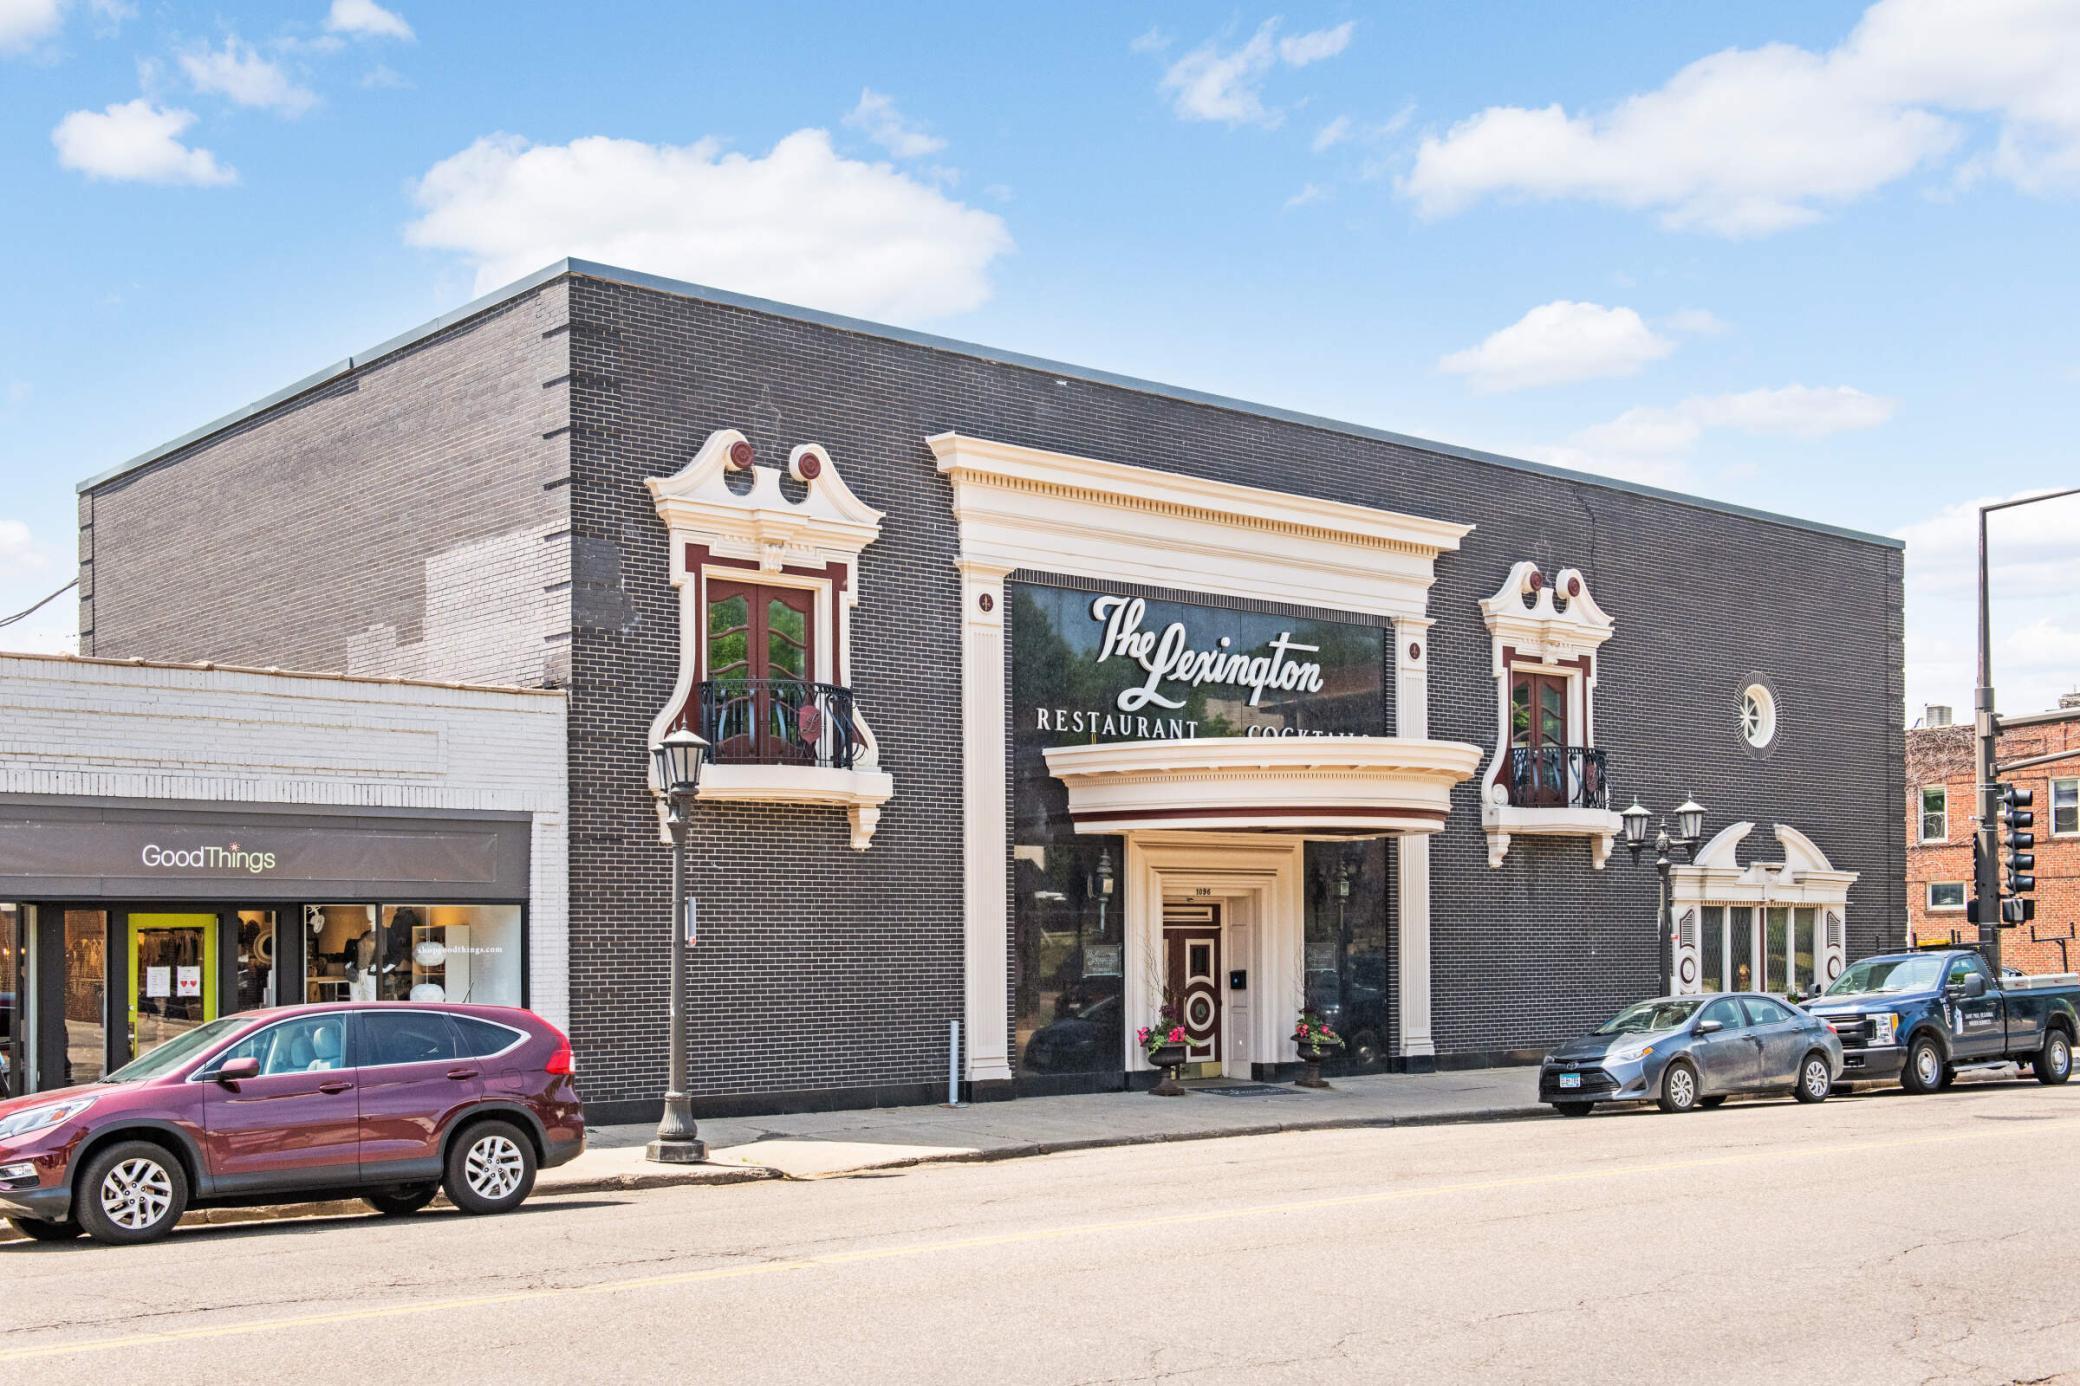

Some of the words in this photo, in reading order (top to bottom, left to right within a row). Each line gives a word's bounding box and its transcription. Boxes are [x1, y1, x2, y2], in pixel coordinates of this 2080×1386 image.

[1093, 596, 1156, 663] The
[1117, 622, 1323, 712] Lexington
[1036, 707, 1199, 739] RESTAURANT
[142, 843, 276, 873] GoodThings
